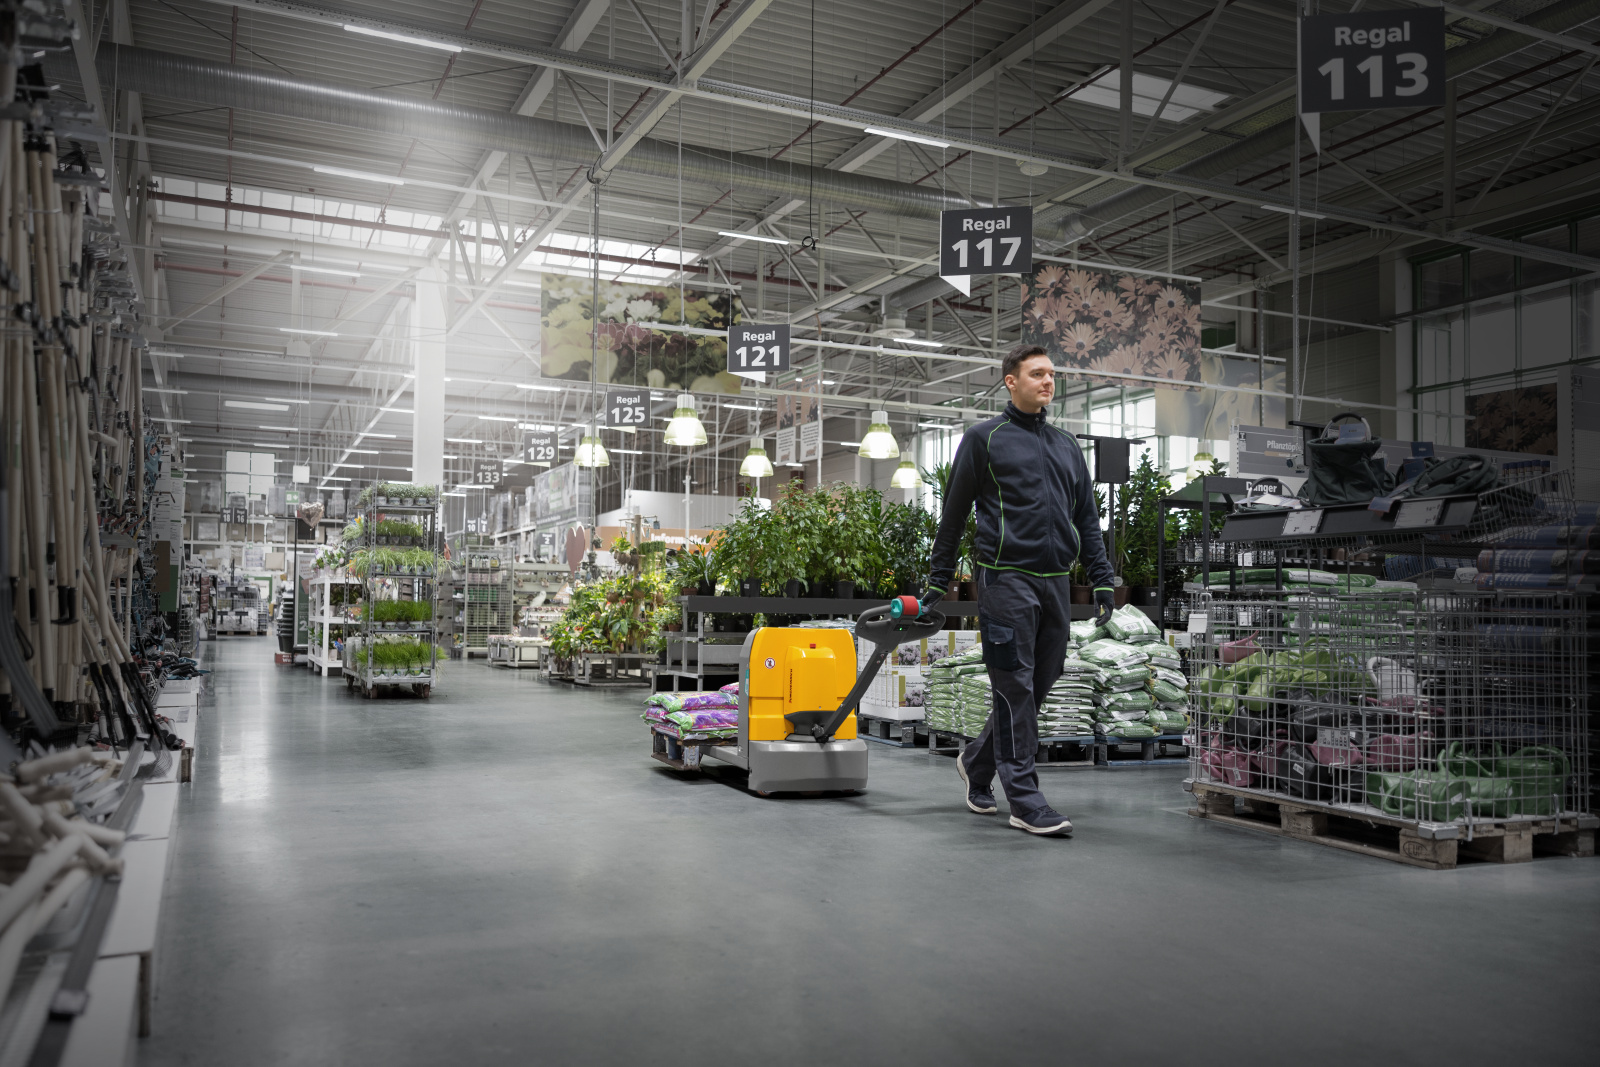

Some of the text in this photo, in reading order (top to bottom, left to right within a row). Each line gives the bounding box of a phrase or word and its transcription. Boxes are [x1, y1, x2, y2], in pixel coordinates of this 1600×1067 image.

[1334, 21, 1411, 49] Regal
[1318, 52, 1429, 101] 113
[962, 215, 1011, 234] Regal
[951, 236, 1022, 268] 117
[742, 330, 776, 343] Regal
[735, 345, 780, 367] 121
[616, 395, 641, 406] Regal
[610, 406, 646, 424] 125
[531, 437, 551, 445] Regal
[527, 446, 555, 460] 129
[476, 471, 500, 483] 133
[223, 514, 231, 522] 18
[236, 514, 245, 523] 16
[467, 524, 476, 532] 10
[650, 532, 710, 546] Informtio
